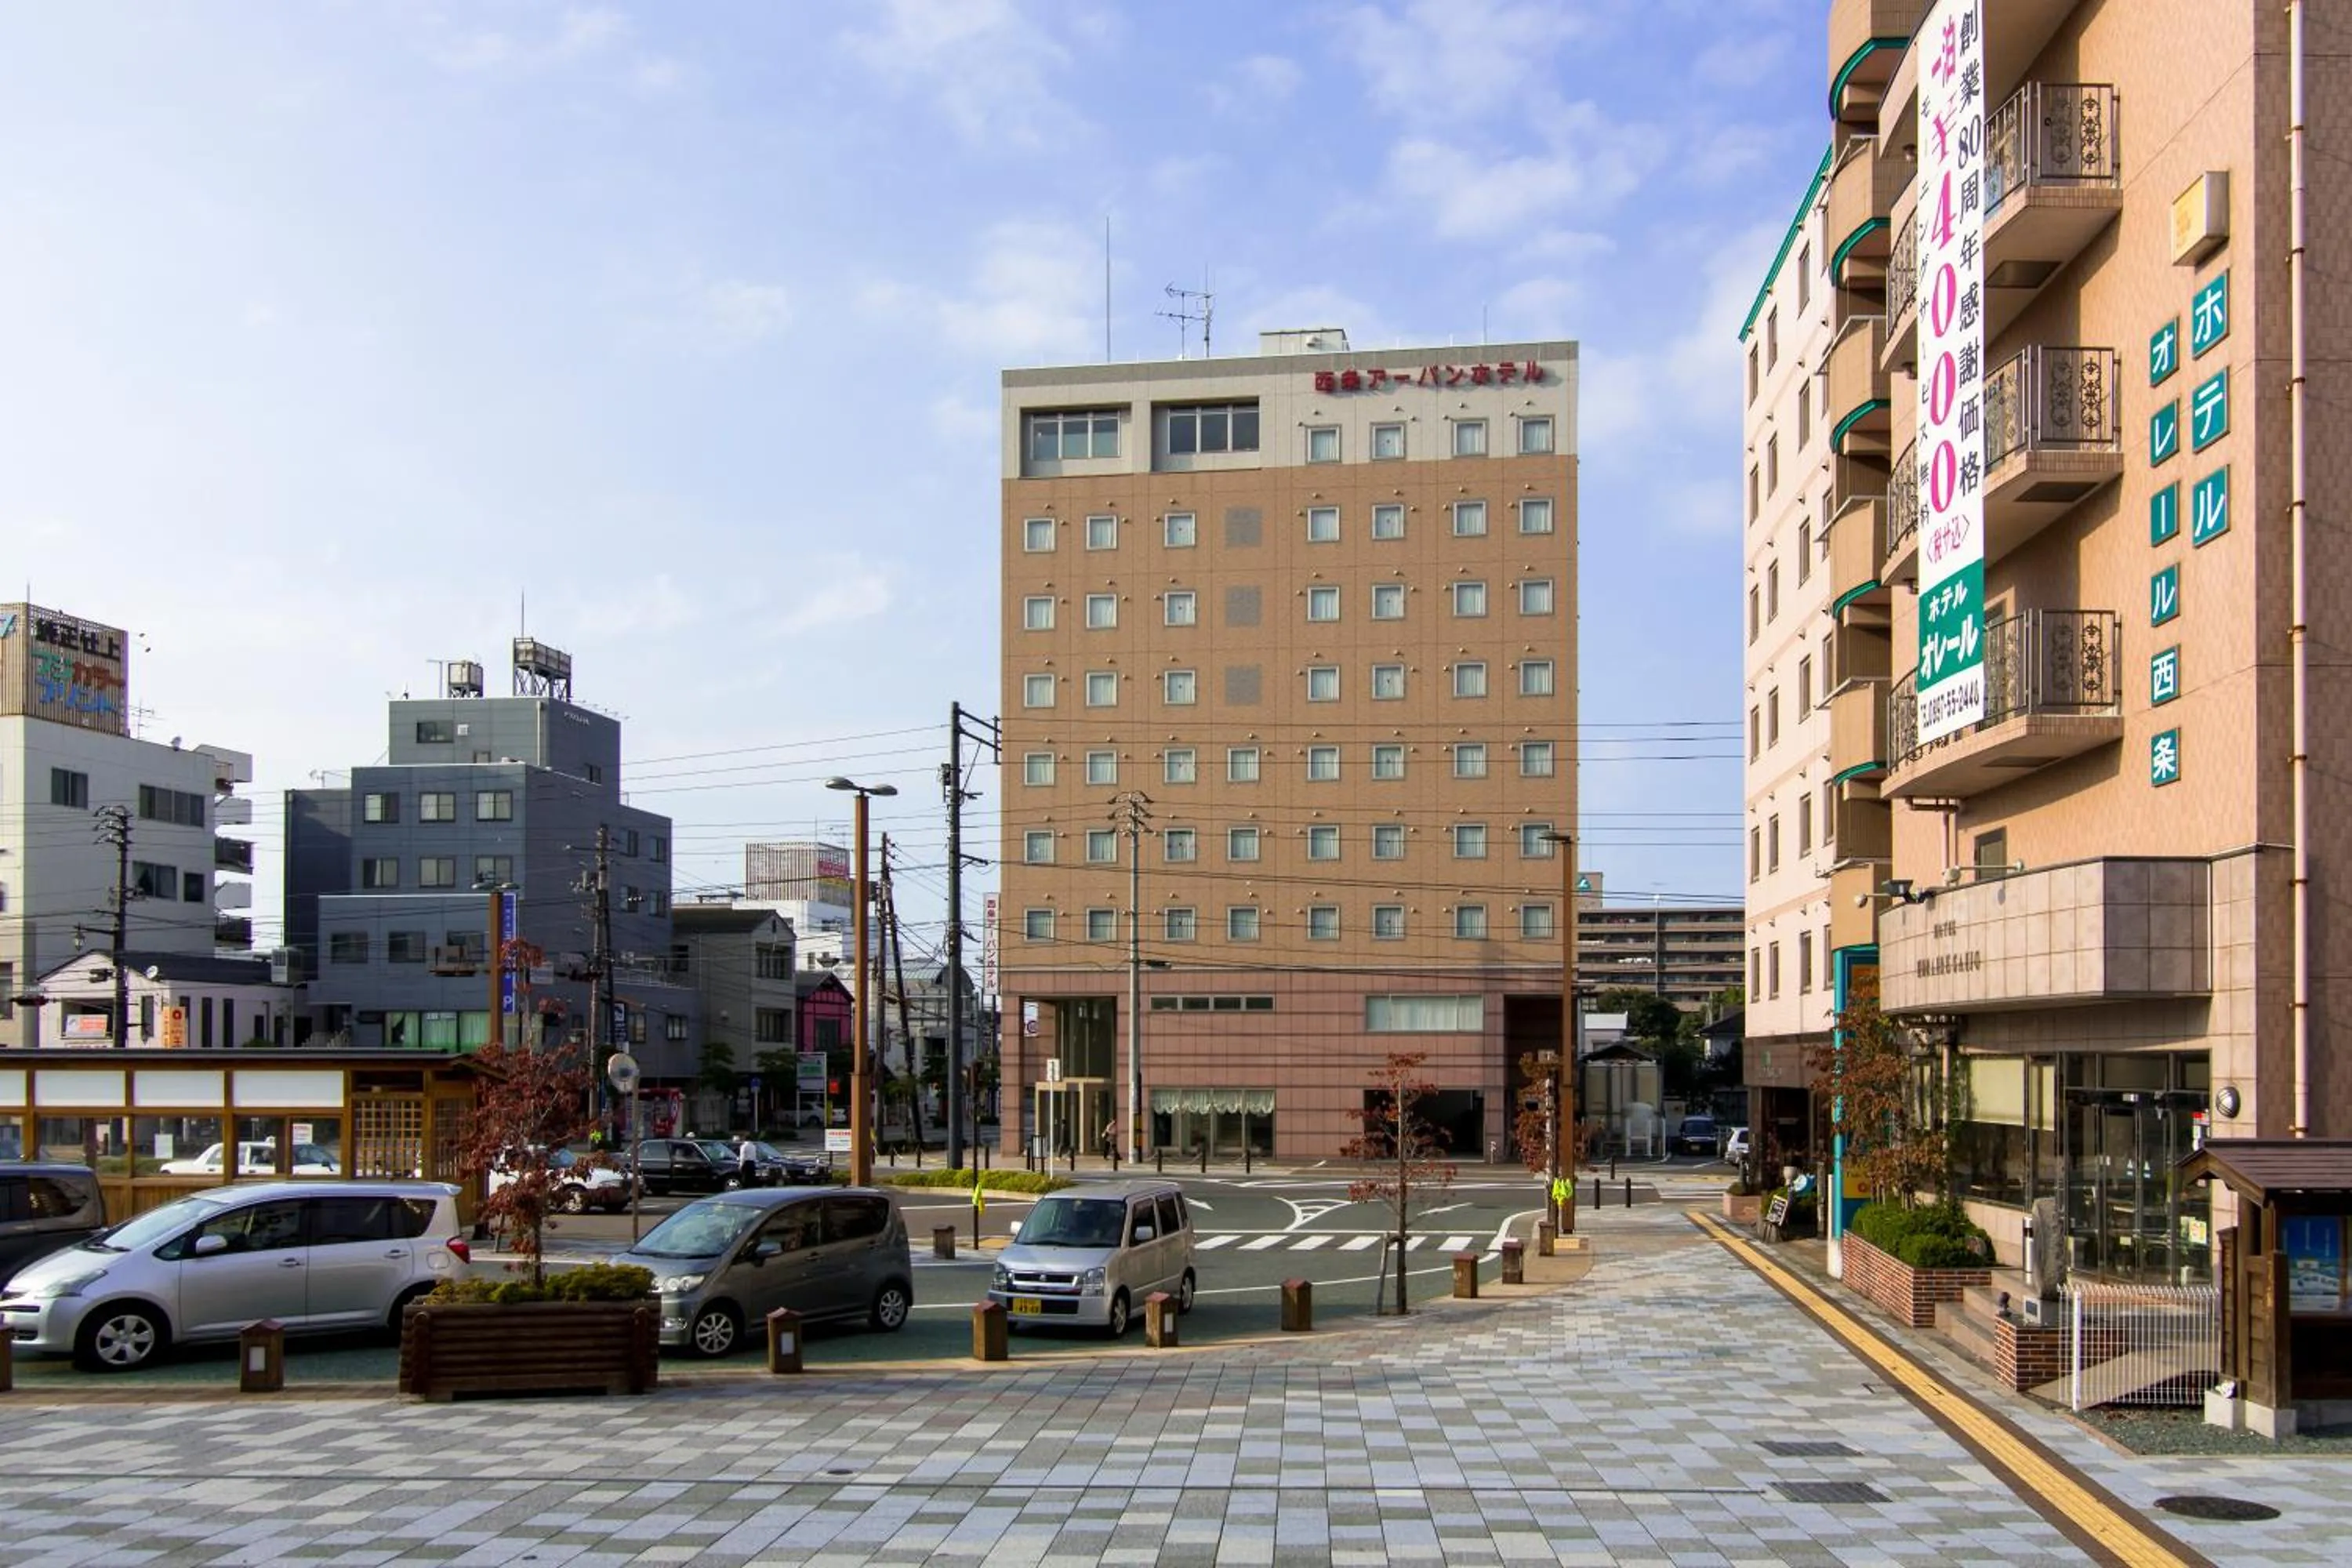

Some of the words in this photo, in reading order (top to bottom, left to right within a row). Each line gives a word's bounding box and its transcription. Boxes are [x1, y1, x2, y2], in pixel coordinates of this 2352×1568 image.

[1959, 0, 1981, 497] 創業80周年感謝価格
[1314, 360, 1544, 392] 西条アーバンホテル
[2195, 289, 2224, 537] ホテル
[1928, 579, 1968, 622] ホテル
[2151, 329, 2176, 778] オレール西条
[1921, 613, 1980, 681] オレール
